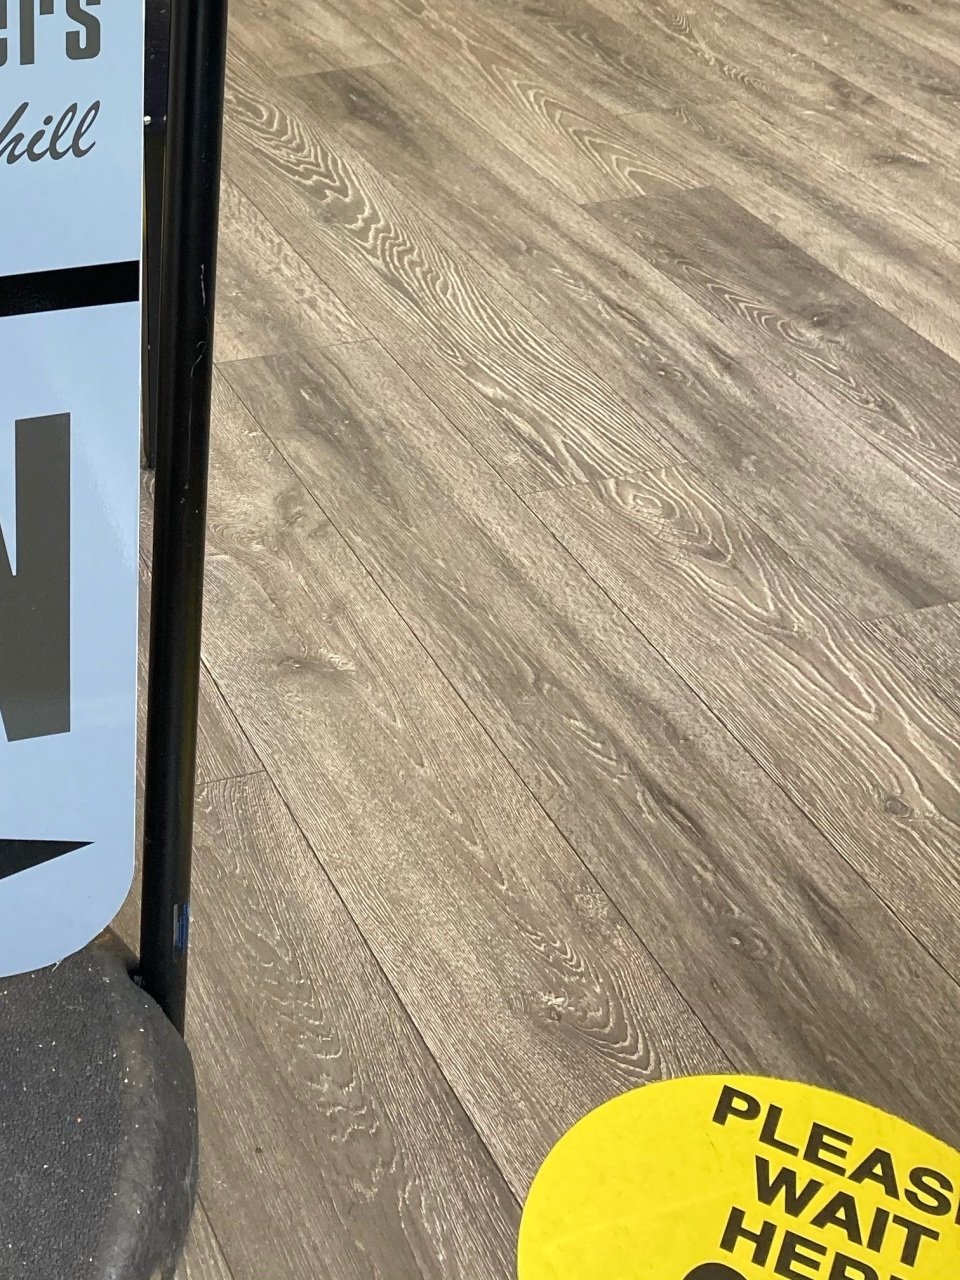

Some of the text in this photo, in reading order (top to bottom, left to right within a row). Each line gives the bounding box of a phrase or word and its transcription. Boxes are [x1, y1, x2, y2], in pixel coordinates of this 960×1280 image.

[712, 1084, 960, 1225] PLEAS
[754, 1154, 941, 1268] WAIT
[719, 1206, 912, 1280] HE
